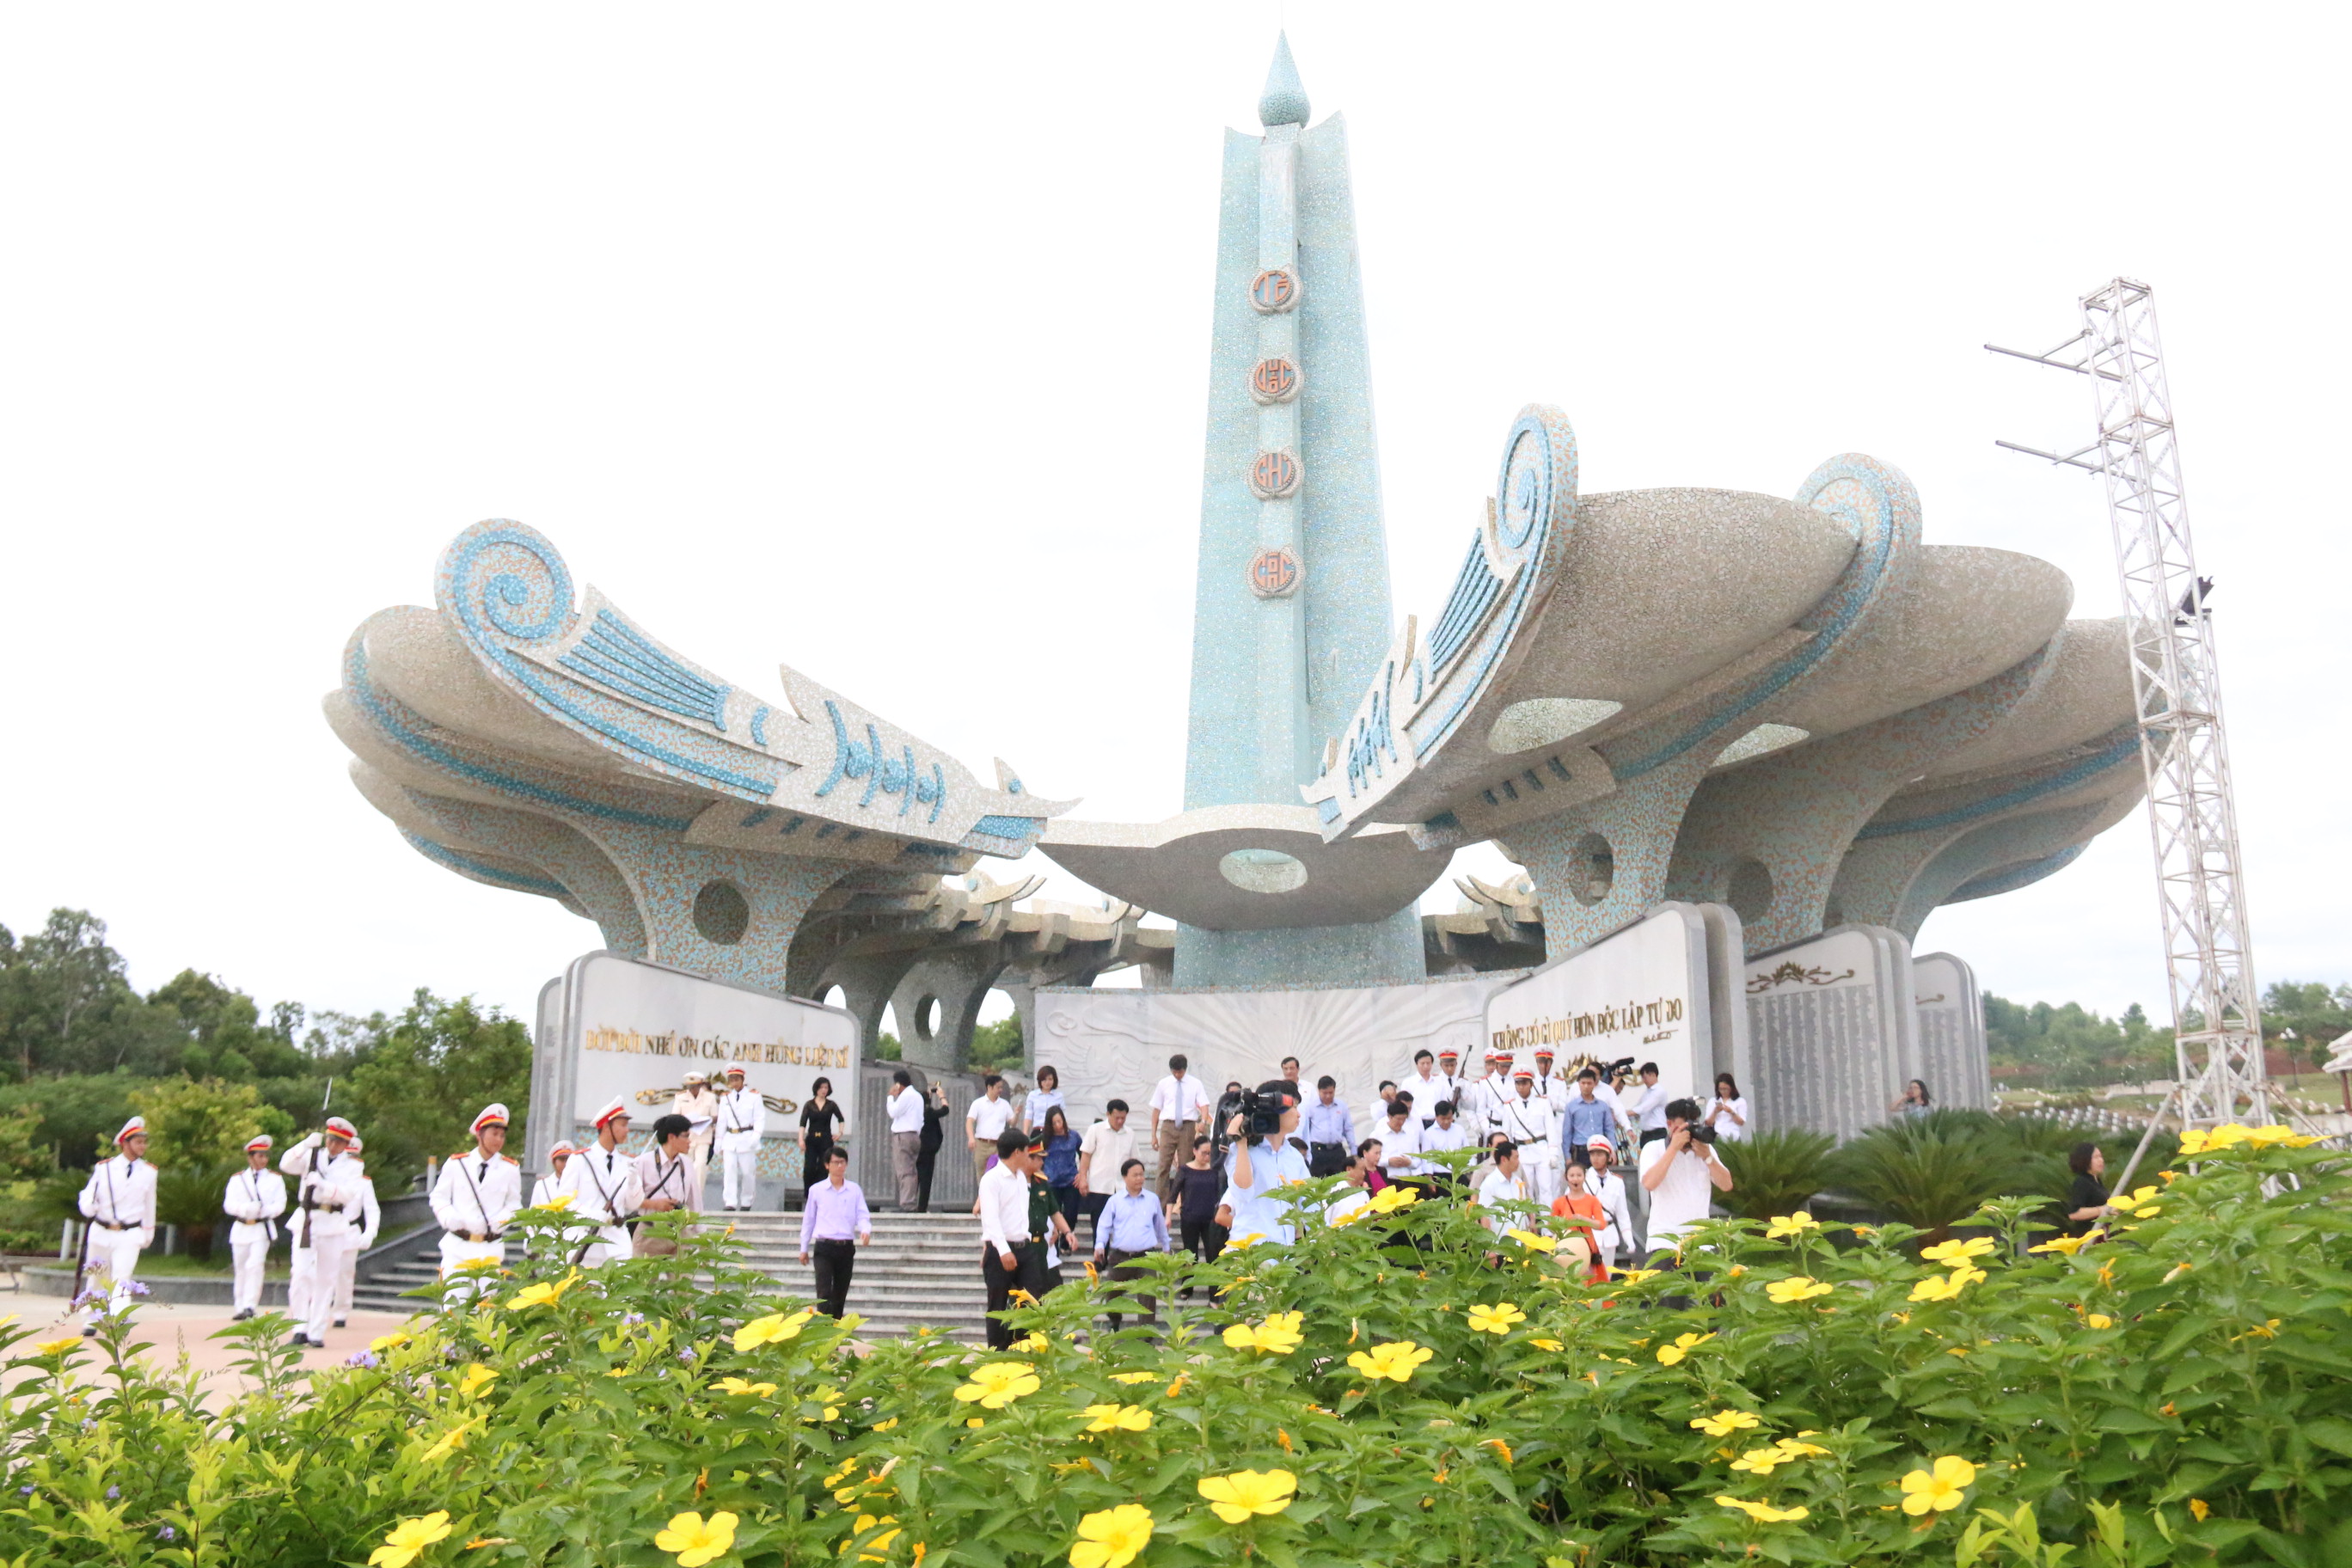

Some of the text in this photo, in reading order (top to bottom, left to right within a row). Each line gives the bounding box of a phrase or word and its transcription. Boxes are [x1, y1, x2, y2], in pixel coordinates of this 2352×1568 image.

[1492, 1024, 1524, 1050] KHÔNG
[1541, 1016, 1551, 1044] GÌ
[1553, 1012, 1572, 1047] QUÝ
[1574, 1013, 1596, 1038] HƠN
[1597, 1005, 1619, 1038] ĐỘC
[1622, 1000, 1643, 1034] LẬP
[1646, 997, 1663, 1030] TỰ
[1666, 998, 1682, 1022] DO
[678, 1034, 699, 1058] ƠN
[702, 1035, 730, 1061] CÁC
[733, 1042, 763, 1063] ANH
[805, 1042, 834, 1071] LIỆT
